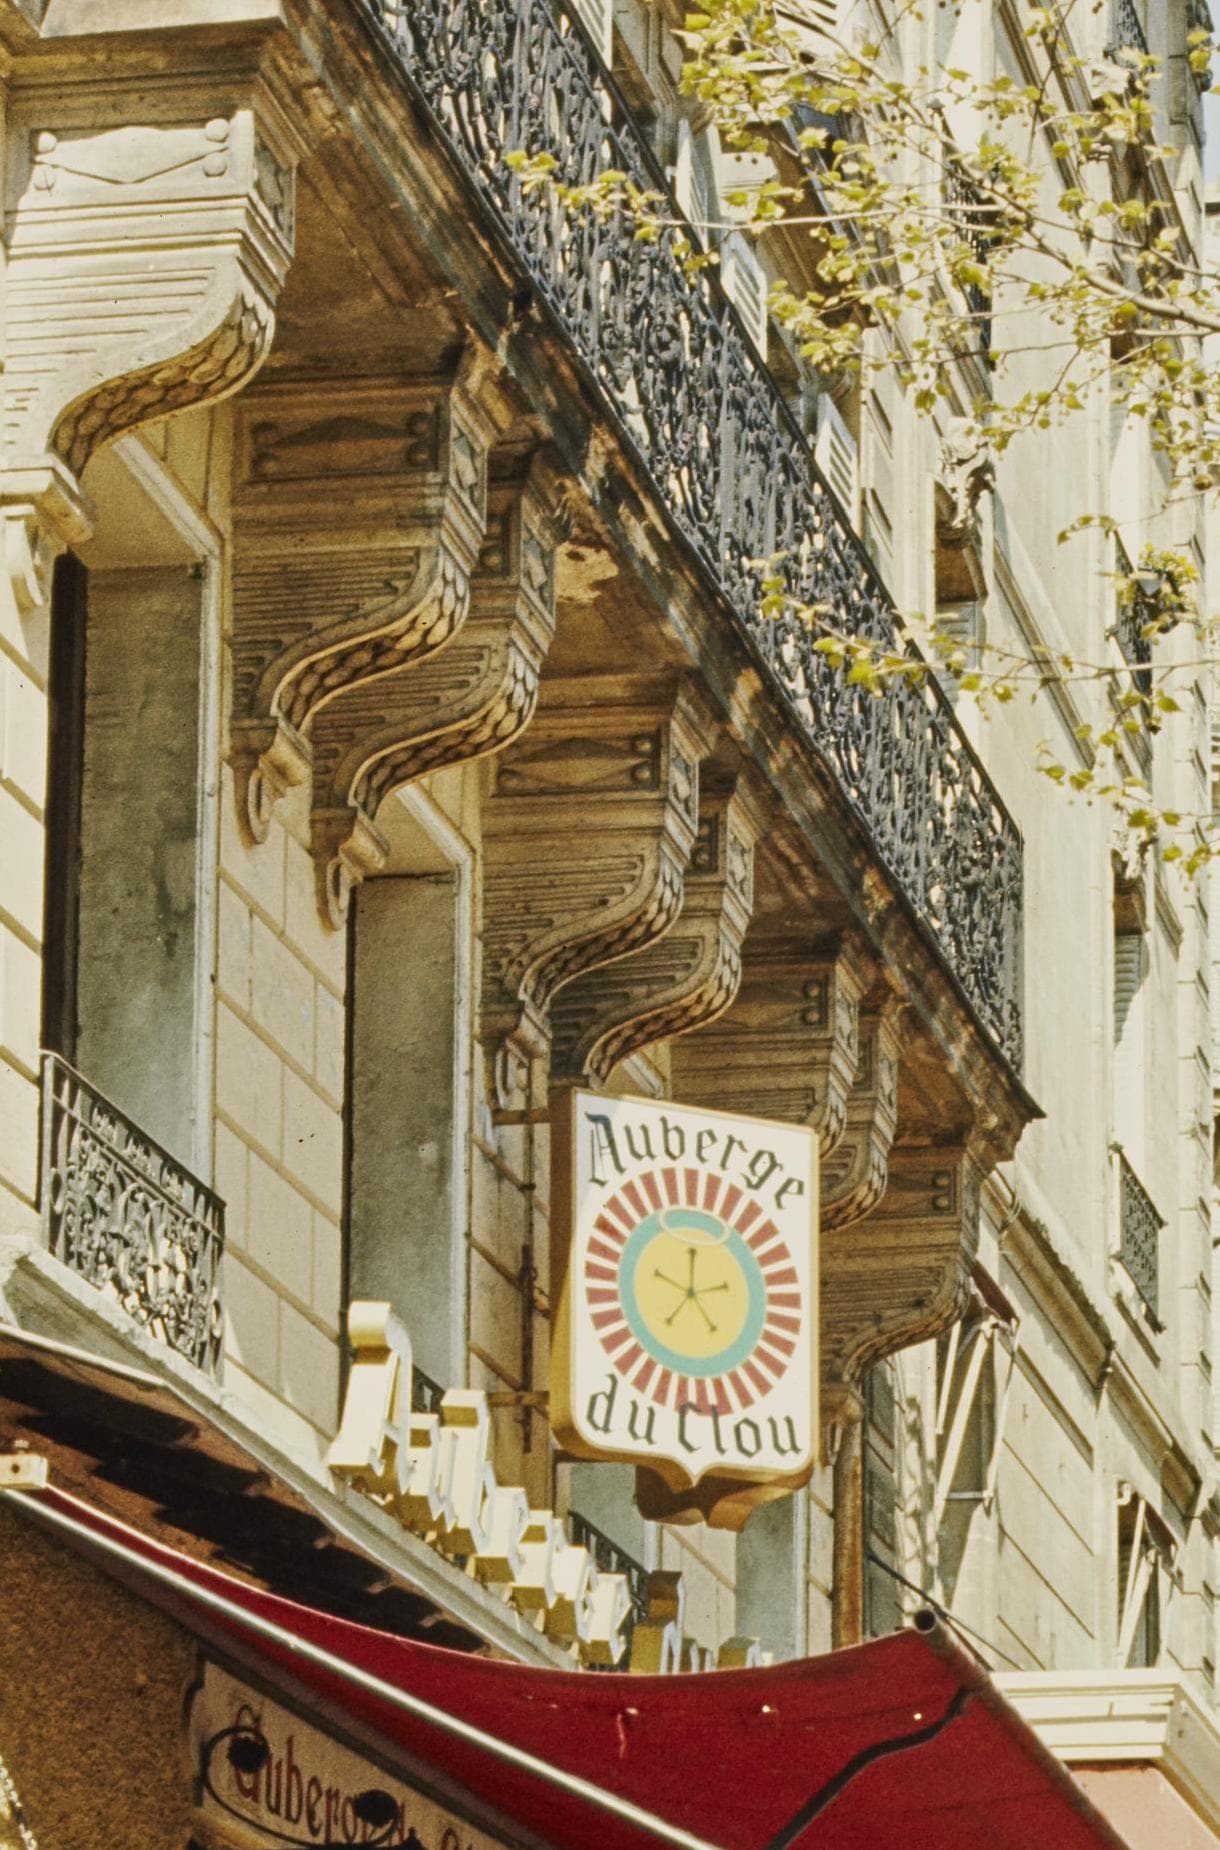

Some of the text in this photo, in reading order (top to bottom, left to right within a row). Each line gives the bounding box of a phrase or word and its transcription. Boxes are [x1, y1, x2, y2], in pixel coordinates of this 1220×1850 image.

[585, 1111, 804, 1210] Auberge
[586, 1374, 801, 1458] du Clou
